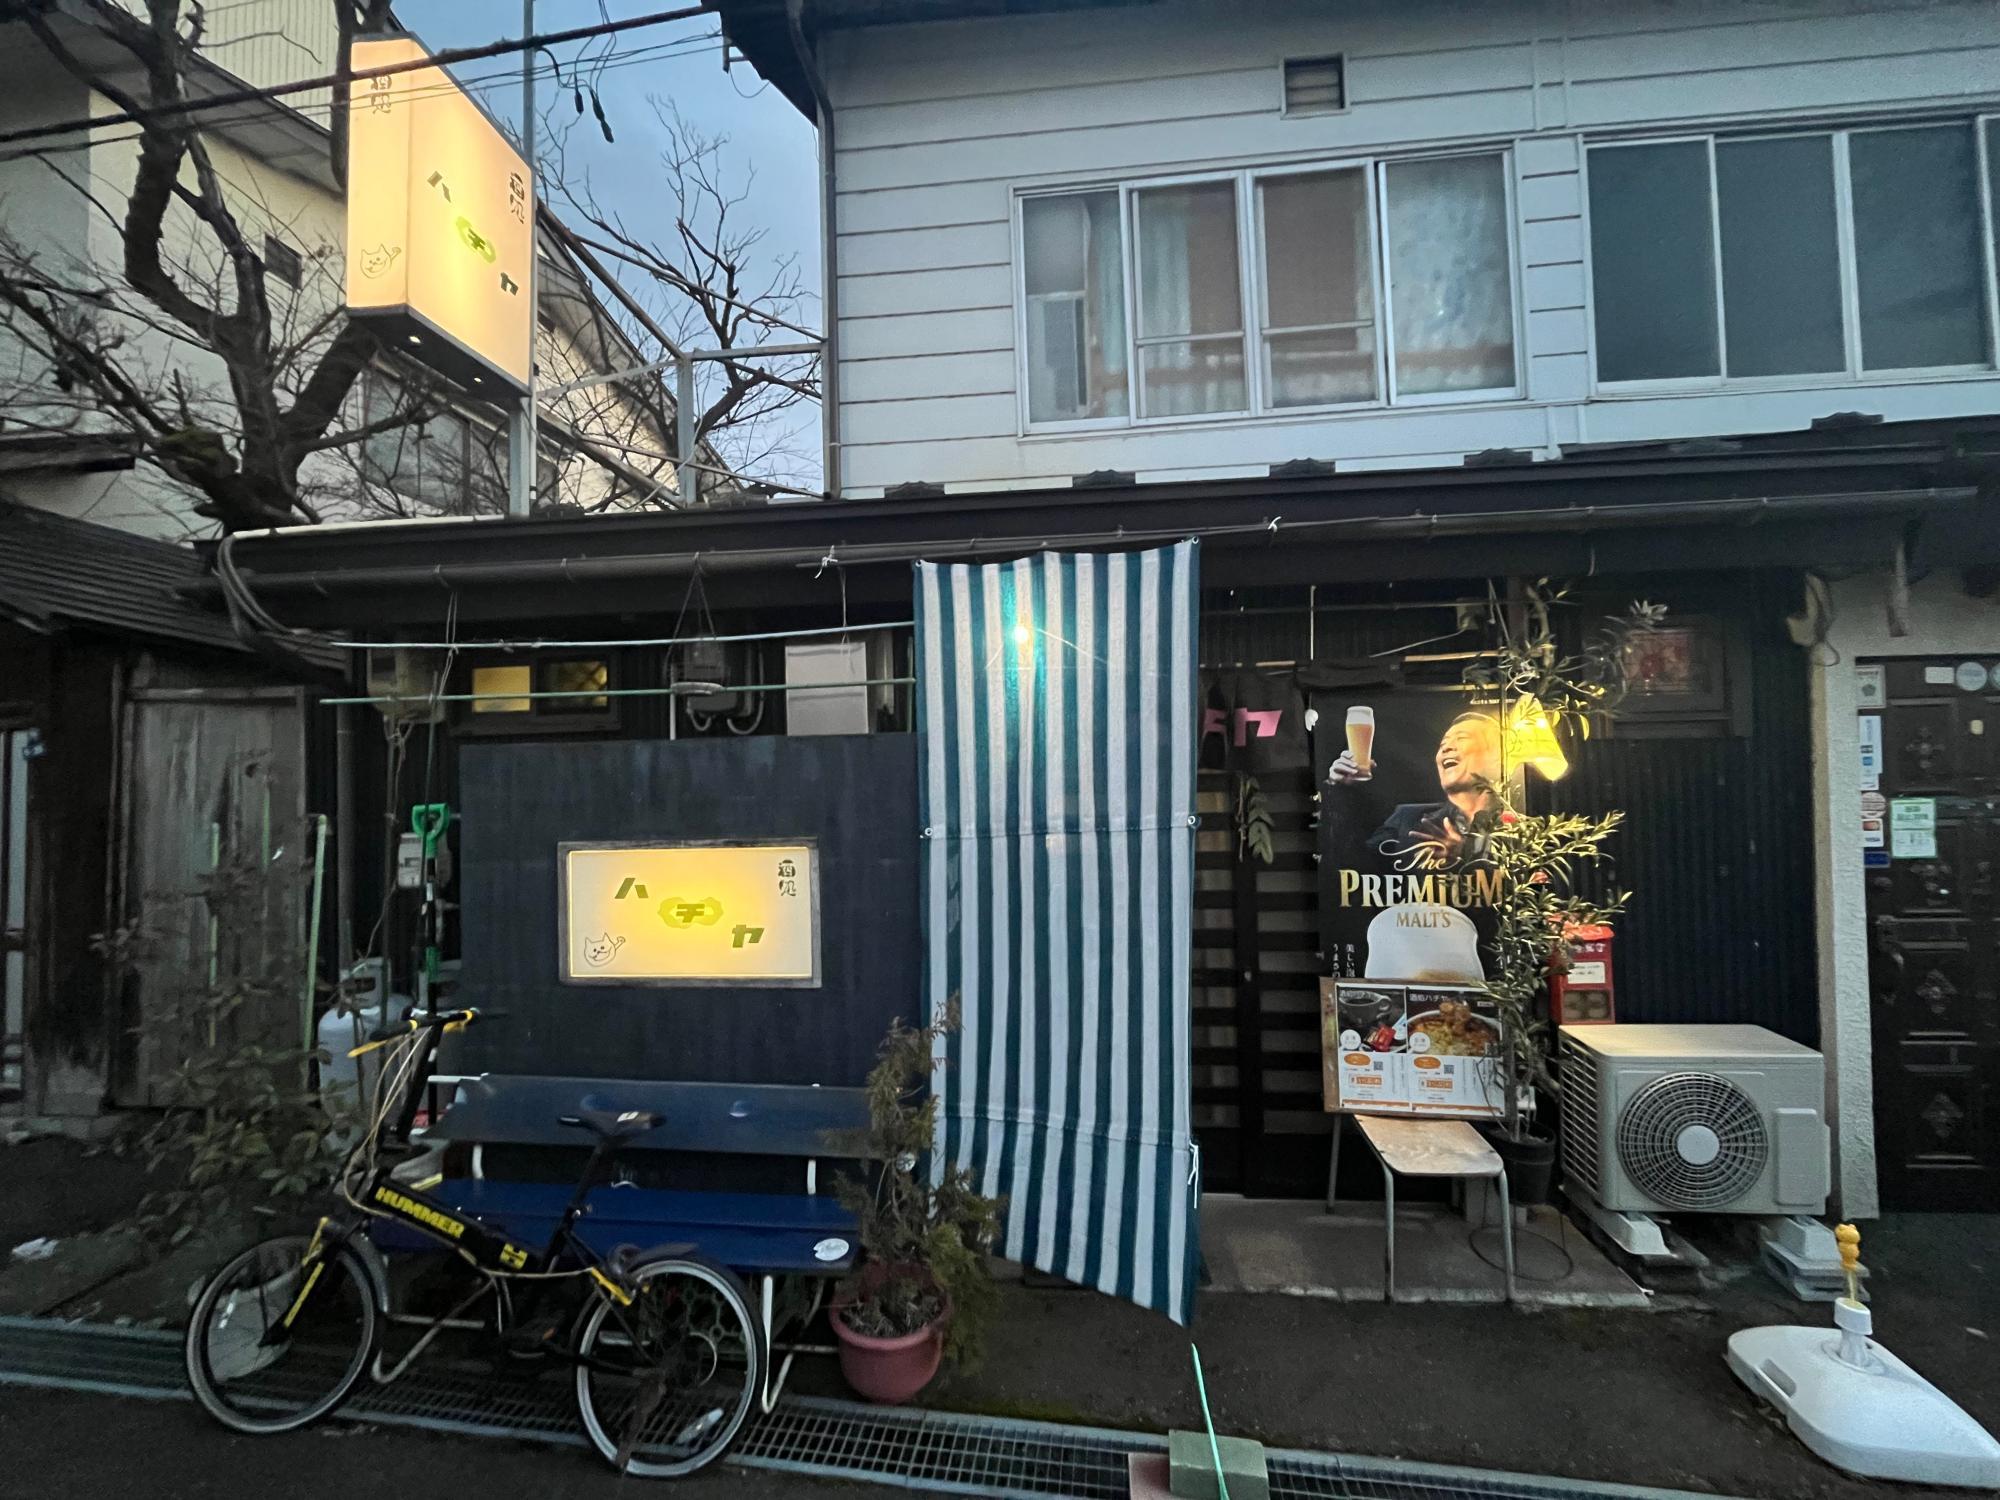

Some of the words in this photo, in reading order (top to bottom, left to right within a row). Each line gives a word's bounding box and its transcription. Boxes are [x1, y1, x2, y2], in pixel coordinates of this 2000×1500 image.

[1378, 838, 1462, 872] The
[777, 859, 797, 897] 酒処
[1338, 869, 1504, 909] PREMIUM
[1396, 909, 1452, 929] MALT'S
[375, 1185, 465, 1239] HUMMER
